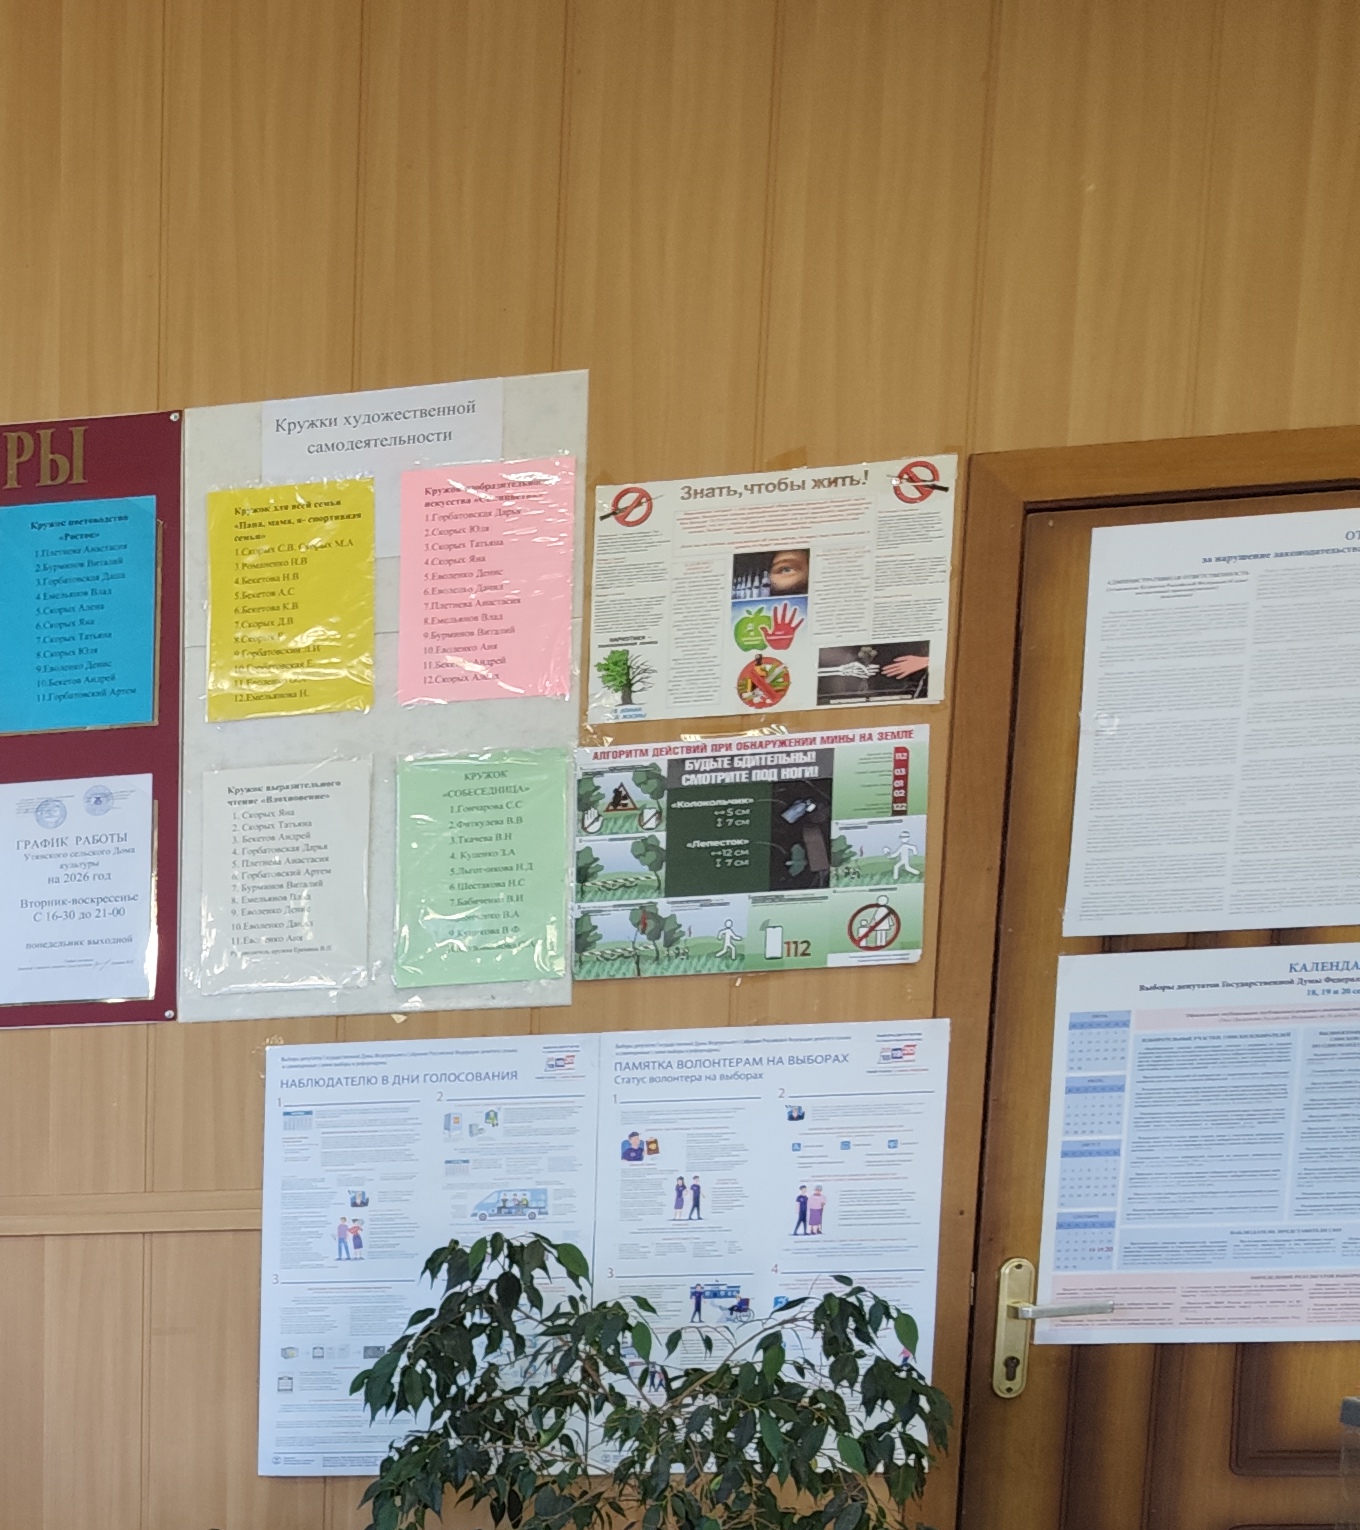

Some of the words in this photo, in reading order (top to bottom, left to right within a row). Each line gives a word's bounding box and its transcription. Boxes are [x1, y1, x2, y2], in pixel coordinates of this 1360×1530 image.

[275, 415, 338, 435] Кружки
[343, 400, 476, 429] художественной
[307, 429, 453, 454] самодеятельности
[811, 469, 870, 490] жить!
[30, 521, 66, 530] Кружок
[592, 747, 648, 761] АЛГОРИТМ
[652, 742, 708, 758] ДЕЙСТВИЙ
[711, 741, 733, 753] ПРИ
[736, 736, 816, 751] ОБНАРУЖЕНИИ
[820, 734, 855, 745] МИНЫ
[859, 733, 875, 743] НА
[877, 729, 914, 741] ЗЕМЛЕ
[684, 757, 731, 771] БУДЬТЕ
[734, 751, 816, 768] БДИТЕЛЬНЫ!
[464, 770, 508, 781] КРУЖОК
[681, 771, 750, 786] СМОТРИТЕ
[752, 768, 778, 782] ПОД
[781, 766, 819, 779] НОГИ!
[227, 786, 263, 796] Кружок
[266, 780, 341, 792] выразительного
[16, 836, 69, 850] ГРАФИК
[75, 833, 128, 846] РАБОТЫ
[686, 839, 750, 849] «Лепесток»
[70, 849, 111, 859] сельского
[113, 846, 135, 856] Дома
[60, 861, 99, 870] культуры
[47, 875, 60, 884] на
[63, 872, 90, 883] 2026
[93, 872, 112, 882] год
[20, 894, 139, 910] Вторник-воскресенье
[33, 912, 42, 922] С
[46, 910, 76, 921] 16-30
[79, 911, 91, 920] до
[95, 907, 125, 919] 21-00
[26, 940, 84, 949] понедельник
[87, 935, 133, 946] выходной
[784, 939, 811, 957] 112
[1289, 960, 1360, 973] КАЛЕНДА
[614, 1058, 673, 1072] ПАМЯТКА
[676, 1055, 763, 1069] ВОЛОНТЕРАМ
[767, 1054, 784, 1066] НА
[787, 1052, 850, 1066] ВЫБОРАХ
[280, 1074, 378, 1089] НАБЛЮДАТЕЛЮ
[381, 1073, 389, 1085] В
[392, 1072, 420, 1087] ДНИ
[423, 1070, 518, 1084] ГОЛОСОВАНИЯ
[614, 1074, 646, 1086] Статус
[649, 1073, 702, 1085] волонтера
[705, 1073, 717, 1082] на
[719, 1070, 764, 1082] выборах
[436, 1092, 444, 1102] 2
[778, 1088, 785, 1098] 2
